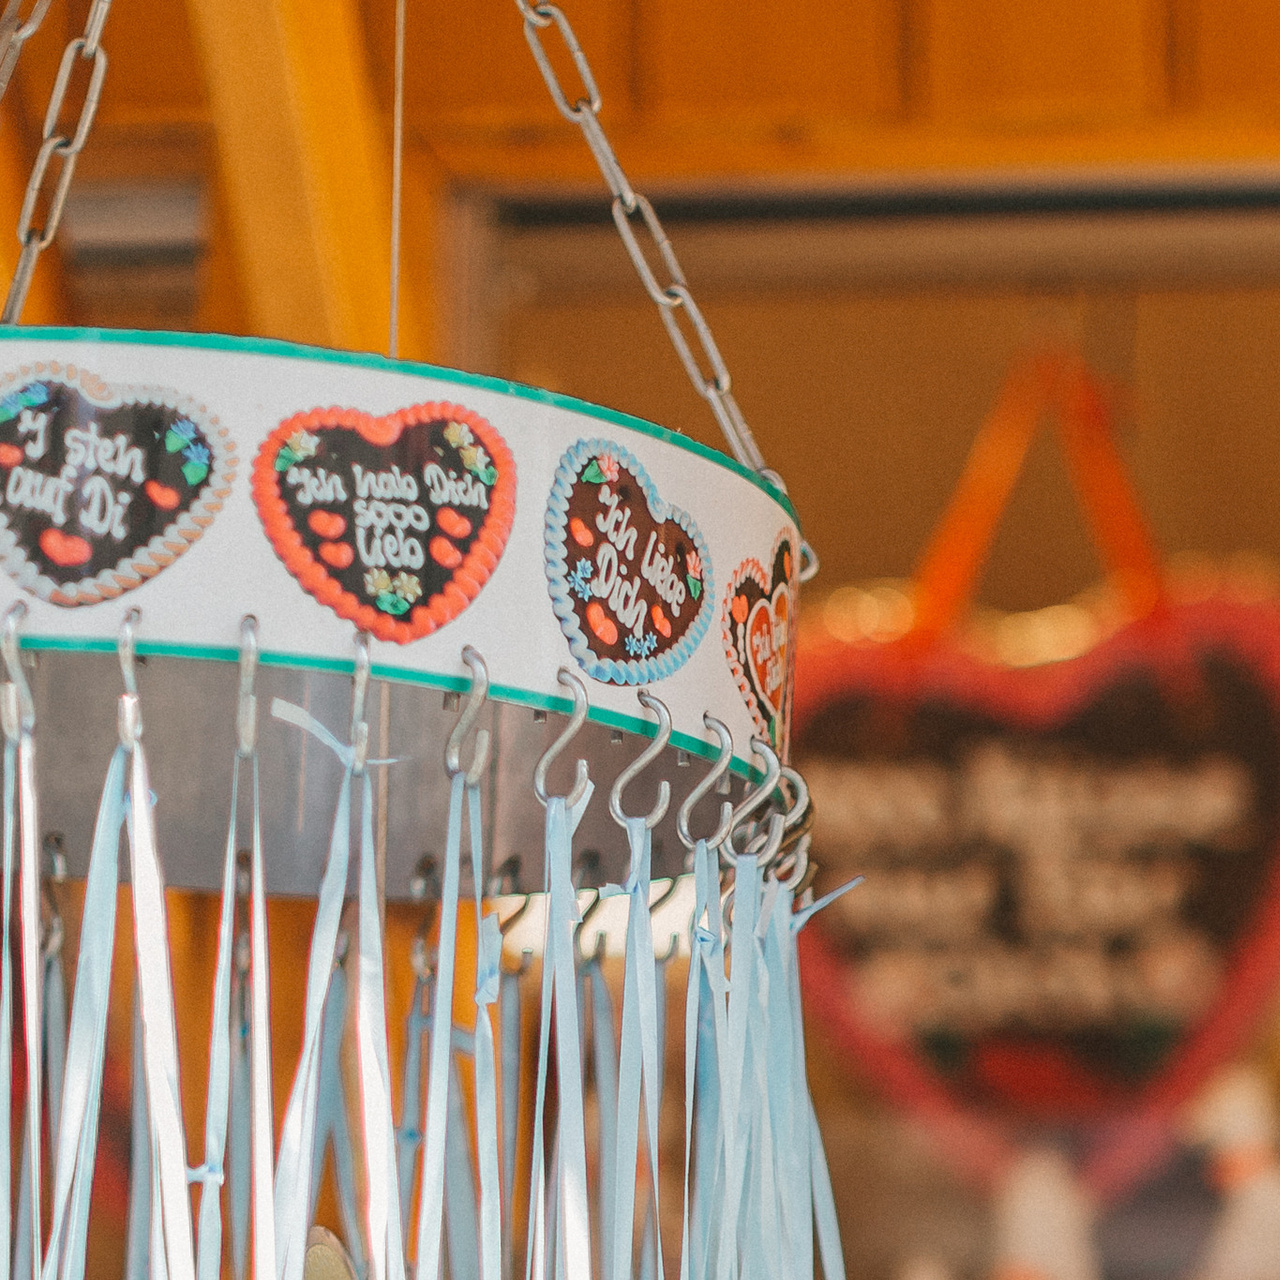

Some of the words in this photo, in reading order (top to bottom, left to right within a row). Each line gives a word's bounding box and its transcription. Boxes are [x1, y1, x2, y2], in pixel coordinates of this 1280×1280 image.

[5, 463, 75, 526] auf
[79, 475, 132, 541] Di
[286, 465, 348, 505] Ich
[352, 462, 419, 502] hab
[423, 461, 489, 510] Dich
[352, 498, 430, 532] sooo
[595, 484, 638, 561] Ich
[590, 541, 648, 639] Dich
